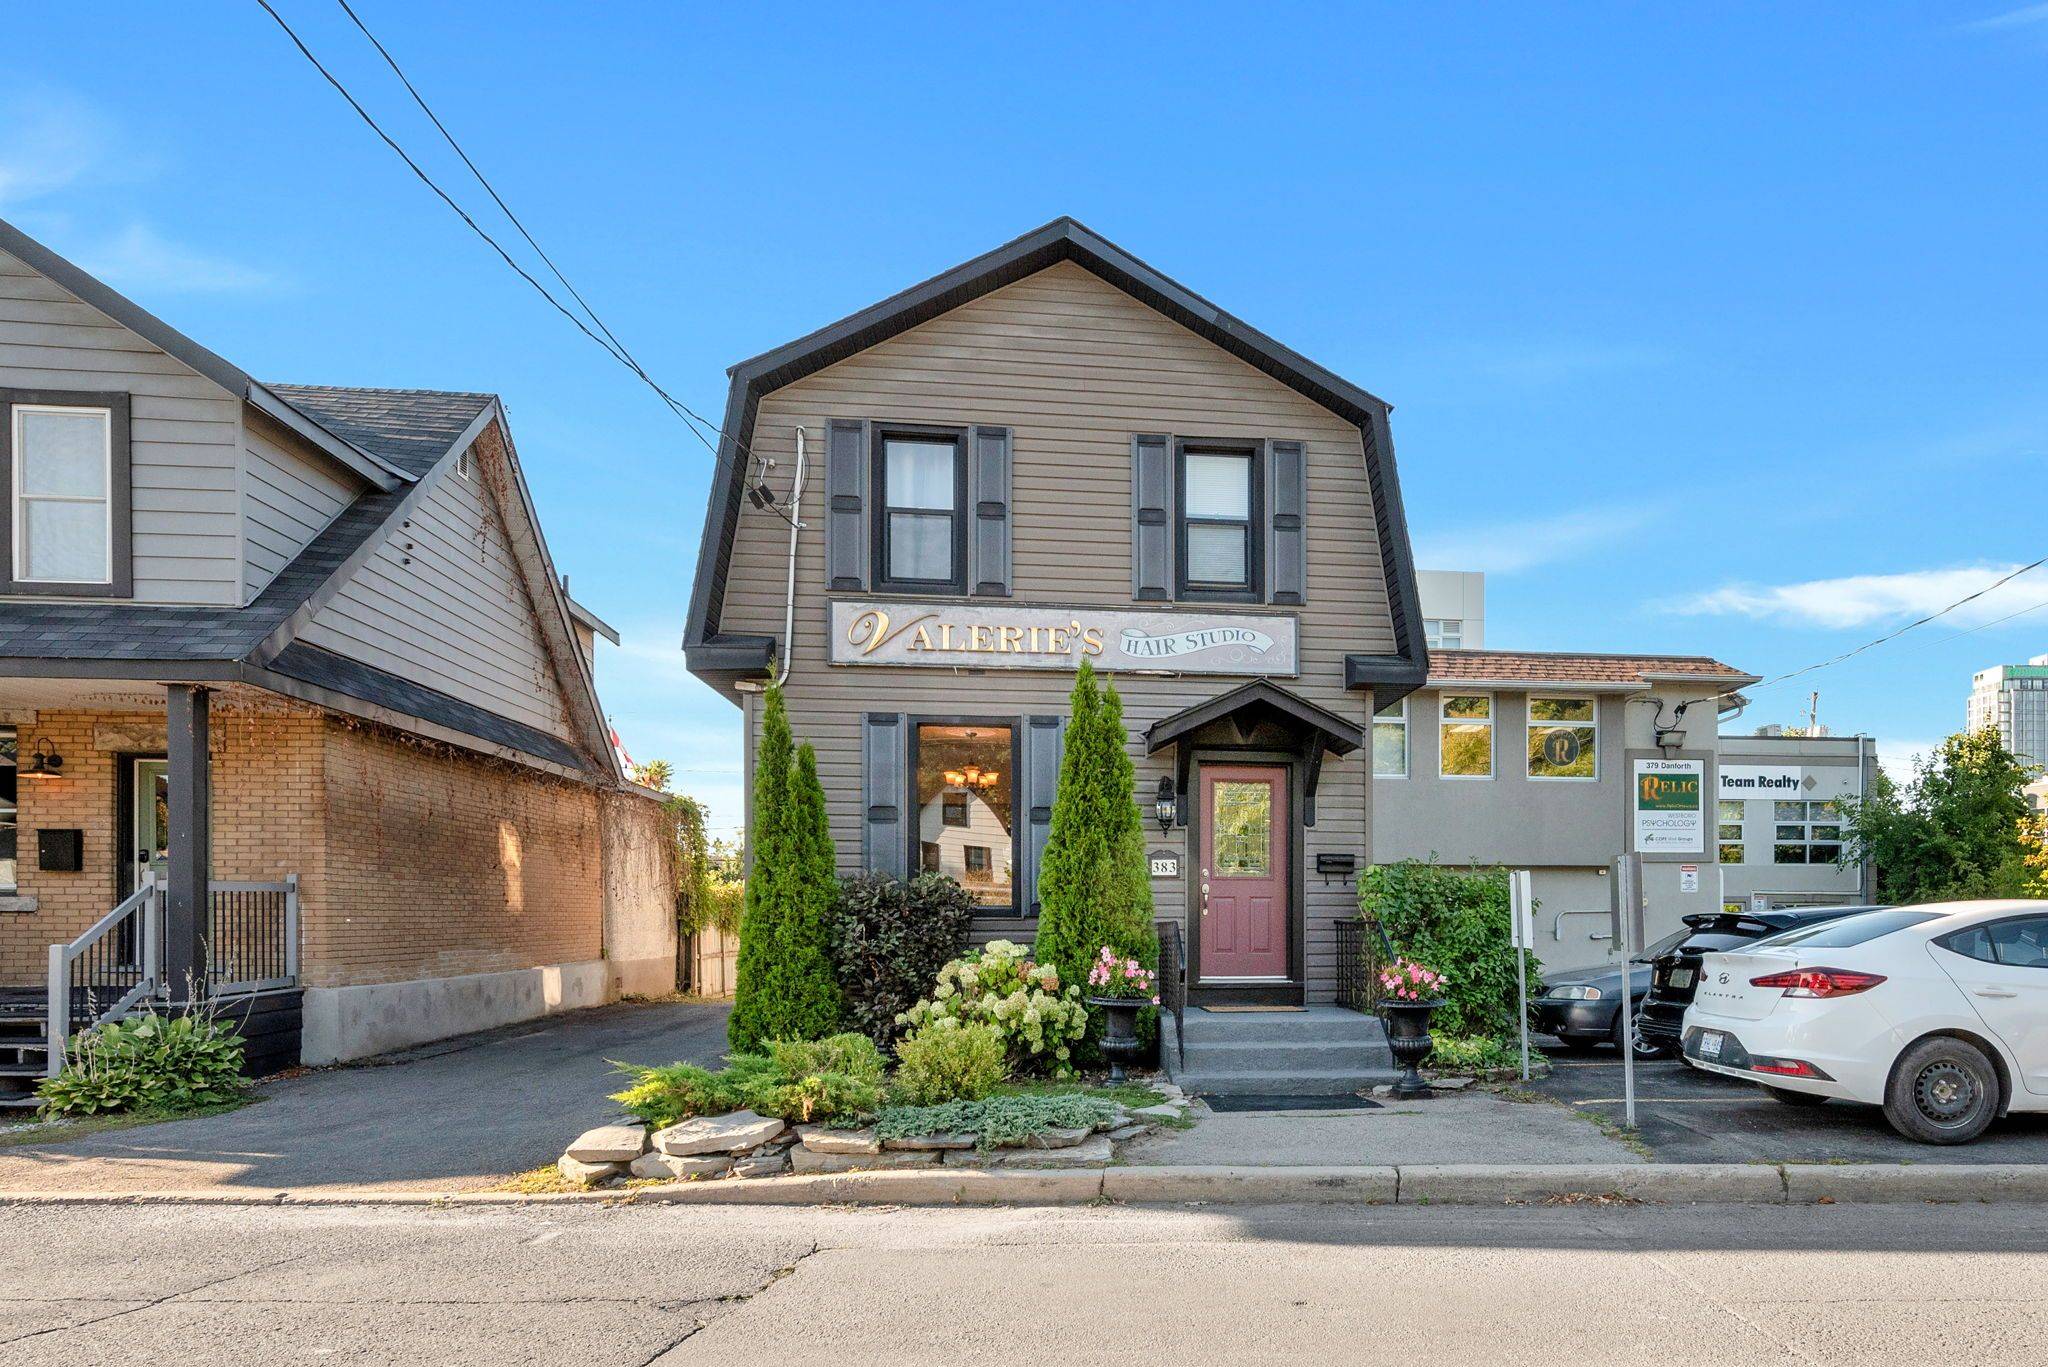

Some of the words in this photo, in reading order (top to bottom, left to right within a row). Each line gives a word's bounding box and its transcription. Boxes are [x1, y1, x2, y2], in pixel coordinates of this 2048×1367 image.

[847, 609, 1105, 656] VALERIE'S
[1126, 637, 1178, 656] HAIR
[1185, 629, 1256, 650] STUDIO
[1721, 775, 1755, 788] Team
[1758, 774, 1800, 791] Realty
[1153, 862, 1176, 873] 383
